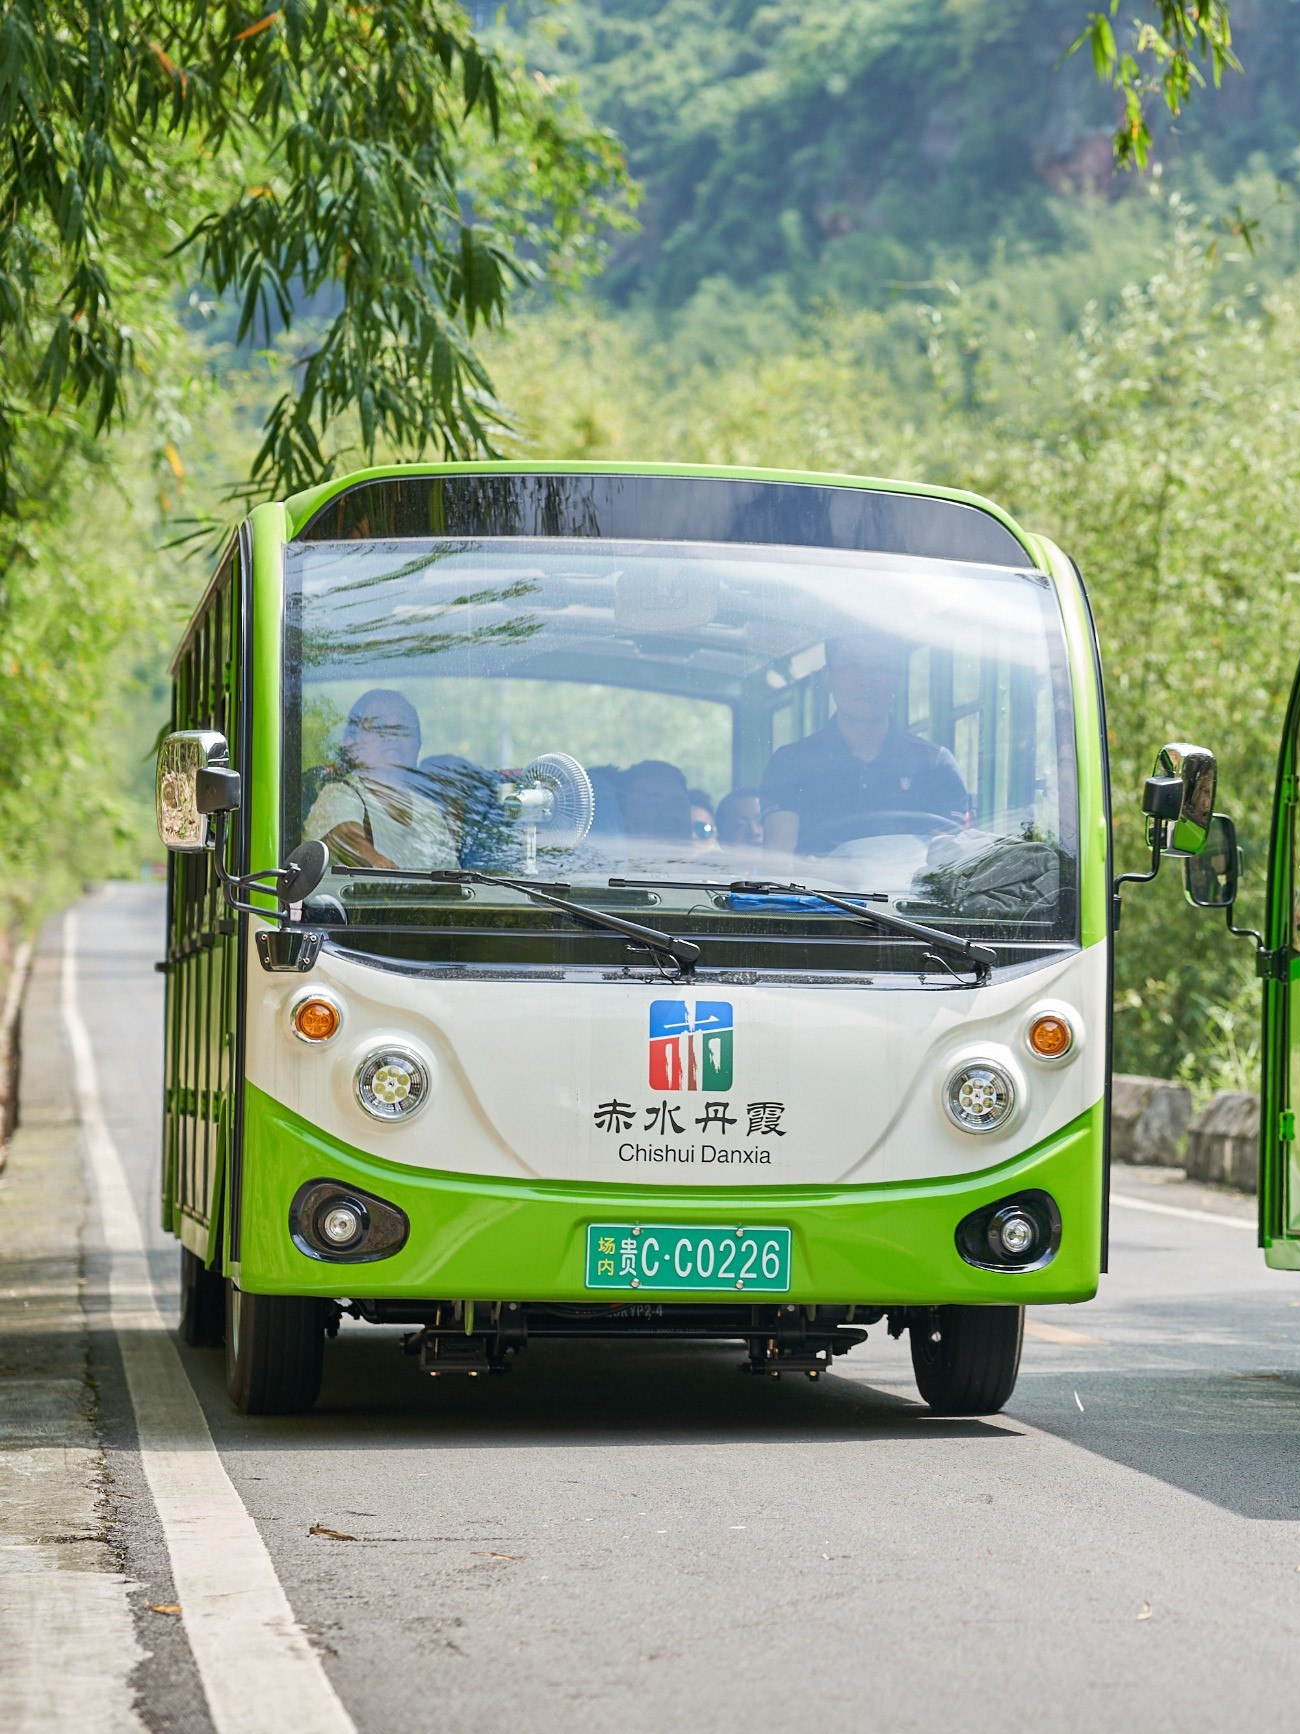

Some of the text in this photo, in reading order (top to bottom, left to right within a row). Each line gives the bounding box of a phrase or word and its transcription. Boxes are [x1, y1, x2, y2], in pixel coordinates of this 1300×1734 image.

[593, 1098, 787, 1137] 赤水丹霞
[618, 1142, 772, 1165] Chishui Danxia
